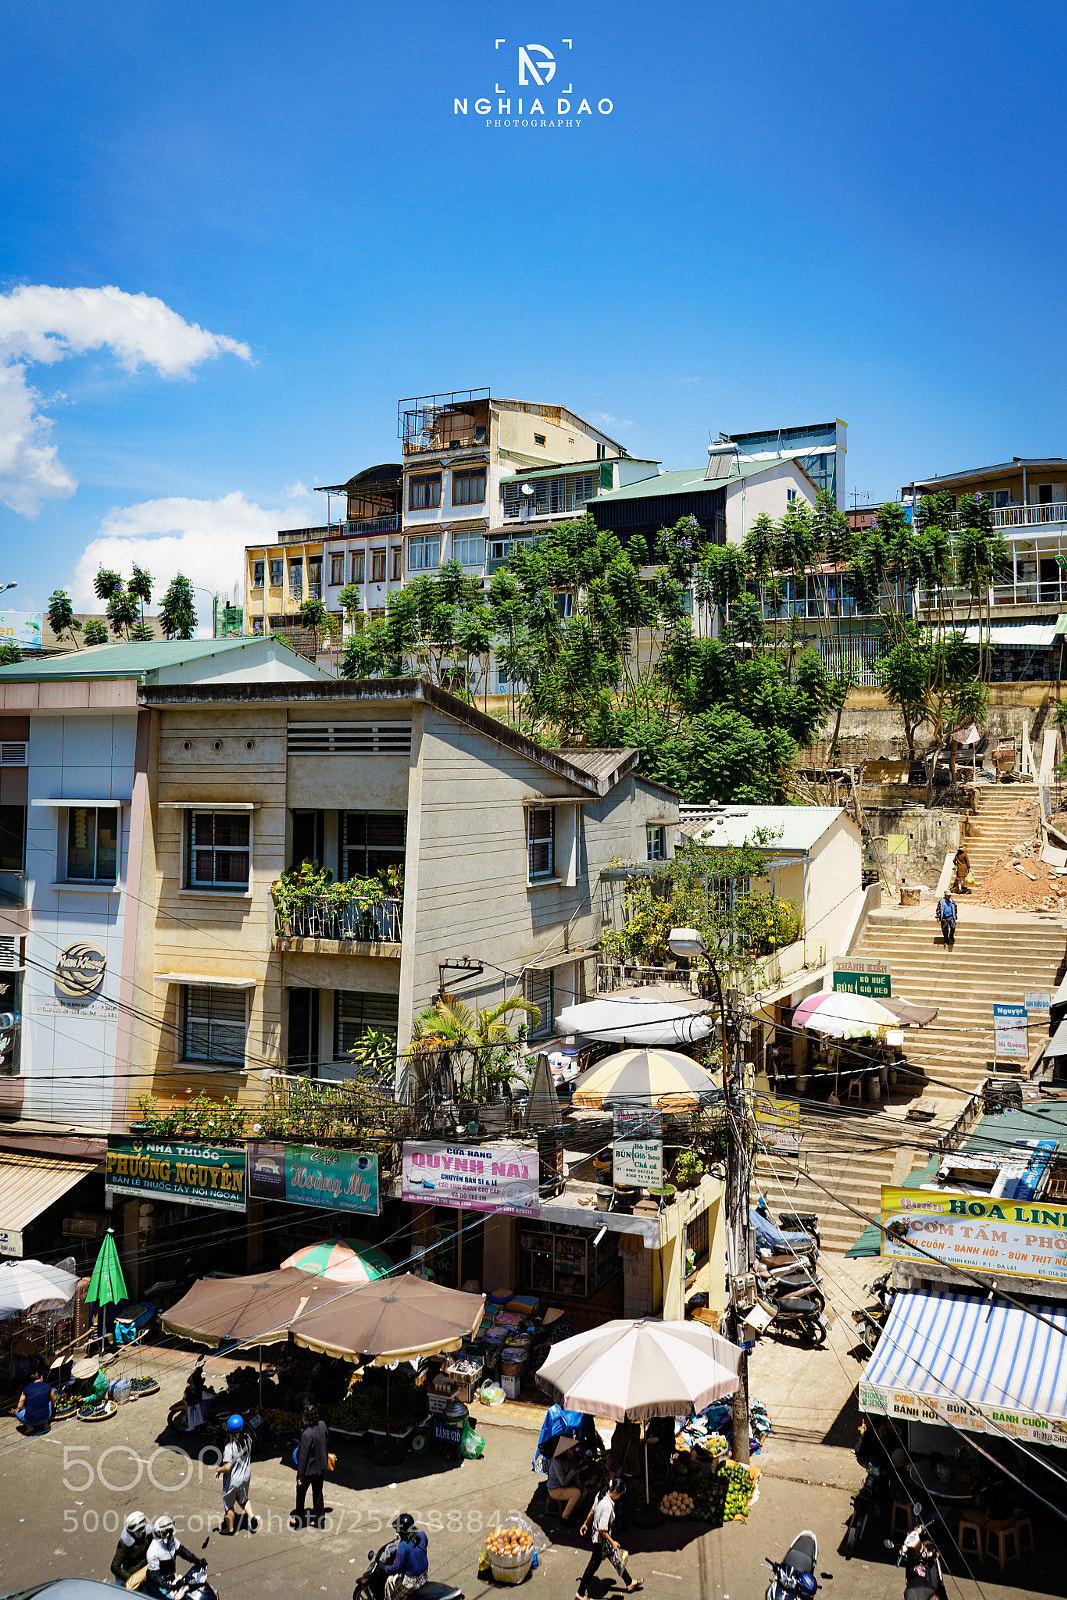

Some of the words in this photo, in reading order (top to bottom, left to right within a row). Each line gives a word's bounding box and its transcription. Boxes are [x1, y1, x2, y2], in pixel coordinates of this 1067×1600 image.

[146, 1143, 173, 1154] NHÀ
[176, 1147, 220, 1161] THUỐC
[615, 1149, 631, 1158] BÚN
[412, 1152, 484, 1175] QUỲNH
[143, 1180, 172, 1191] THUỐC
[175, 1162, 245, 1192] NGUYÊN
[900, 1198, 944, 1212] Quán
[948, 1199, 1007, 1220] HOA
[910, 1220, 955, 1237] CƠM
[960, 1223, 1008, 1243] TẤM
[954, 1244, 980, 1256] BÁNH
[1008, 1250, 1028, 1261] BÚN
[1031, 1254, 1053, 1266] THỊT
[893, 1404, 920, 1417] BÁNH
[947, 1403, 967, 1415] BÚN
[992, 1412, 1019, 1425] BÁNH
